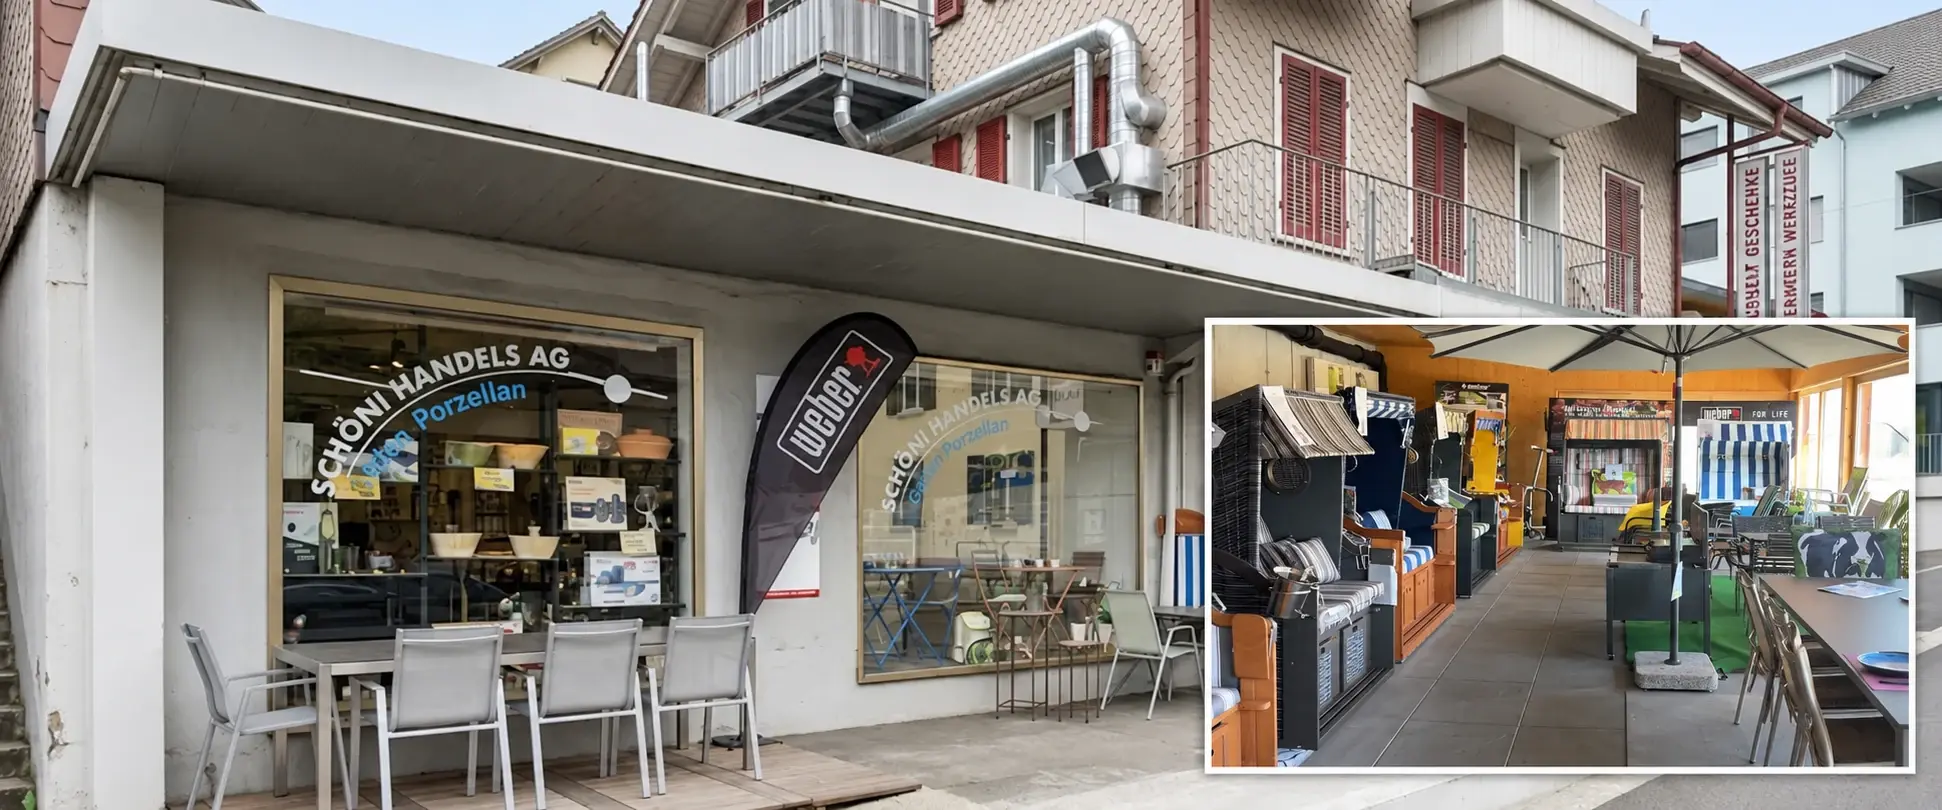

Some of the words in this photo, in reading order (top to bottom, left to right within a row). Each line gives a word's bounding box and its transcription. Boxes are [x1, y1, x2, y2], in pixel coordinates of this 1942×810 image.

[311, 390, 392, 498] SCHÖNI
[388, 343, 522, 401] HANDELS
[529, 345, 570, 369] AG
[411, 380, 527, 431] Porzellan
[789, 365, 862, 458] weber
[942, 418, 1009, 459] Porzellan
[1752, 410, 1767, 419] FOR
[1771, 410, 1789, 418] LIFE
[881, 428, 930, 513] SCHÖNI
[927, 387, 1011, 438] HANDELS
[1015, 388, 1042, 407] AG
